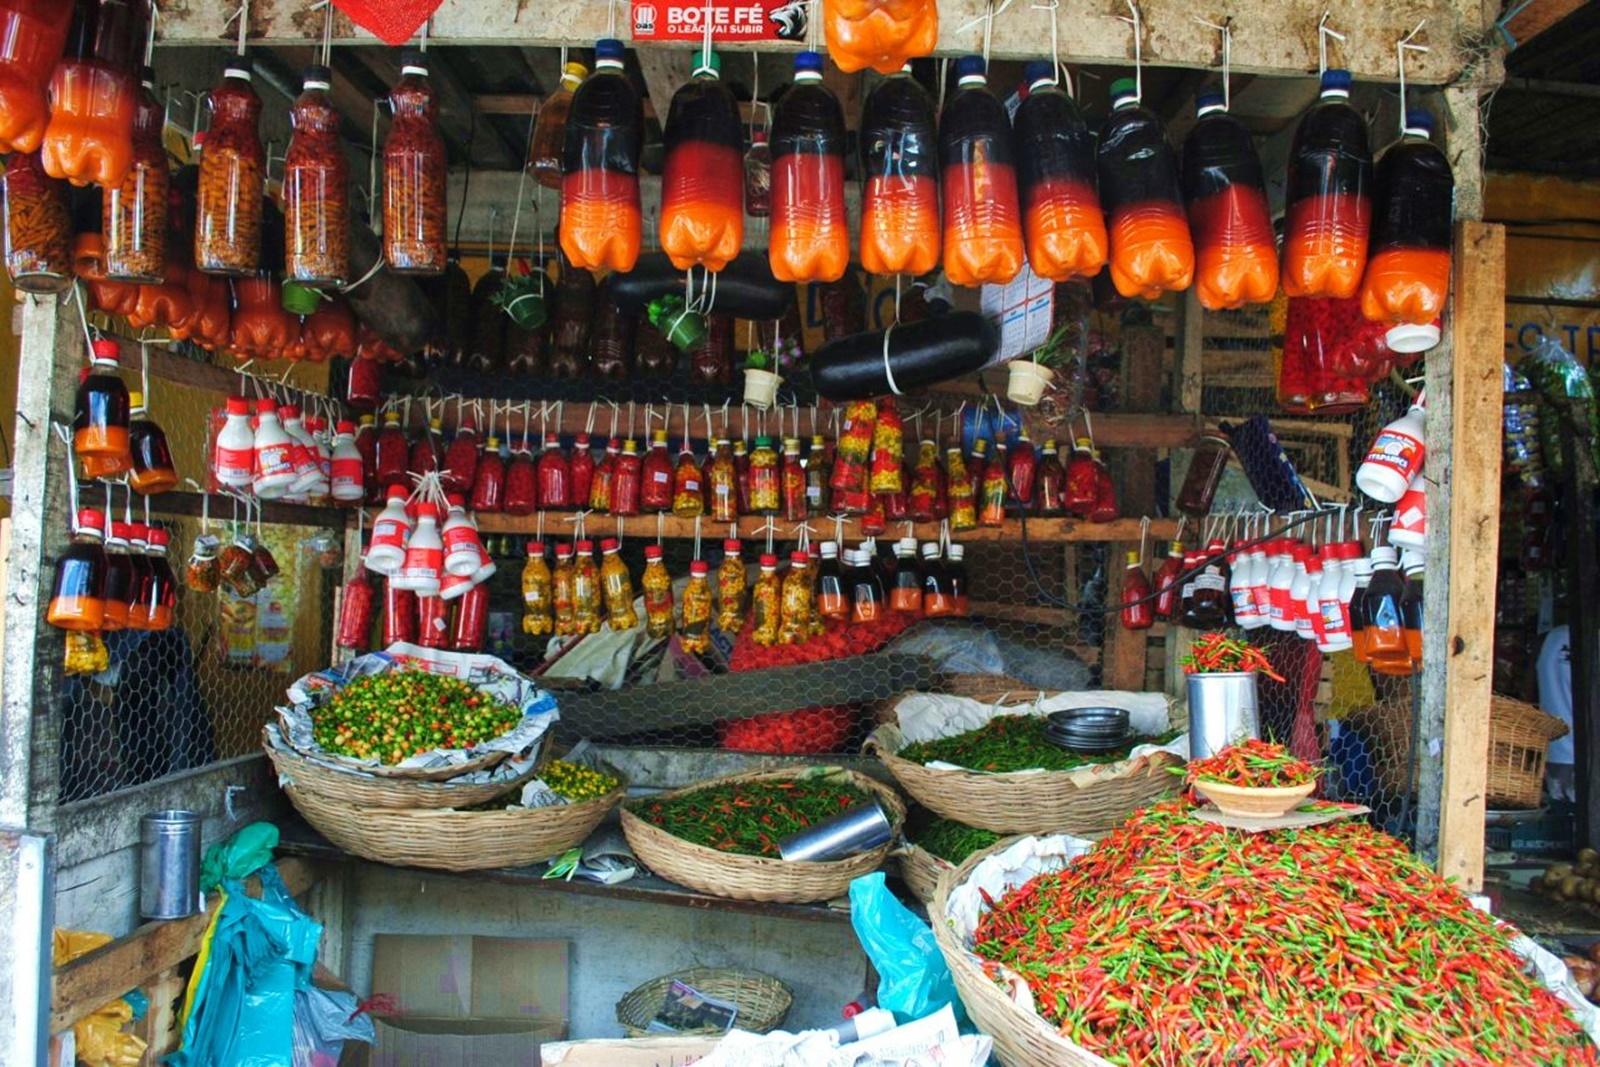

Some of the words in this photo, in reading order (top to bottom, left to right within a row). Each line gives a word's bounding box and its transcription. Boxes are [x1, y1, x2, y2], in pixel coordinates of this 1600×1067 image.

[667, 6, 730, 24] BOTE
[734, 3, 764, 24] FÉ
[667, 25, 677, 33] O
[678, 23, 706, 34] LEÃO
[709, 25, 728, 33] VAI
[729, 25, 763, 34] SUBIR
